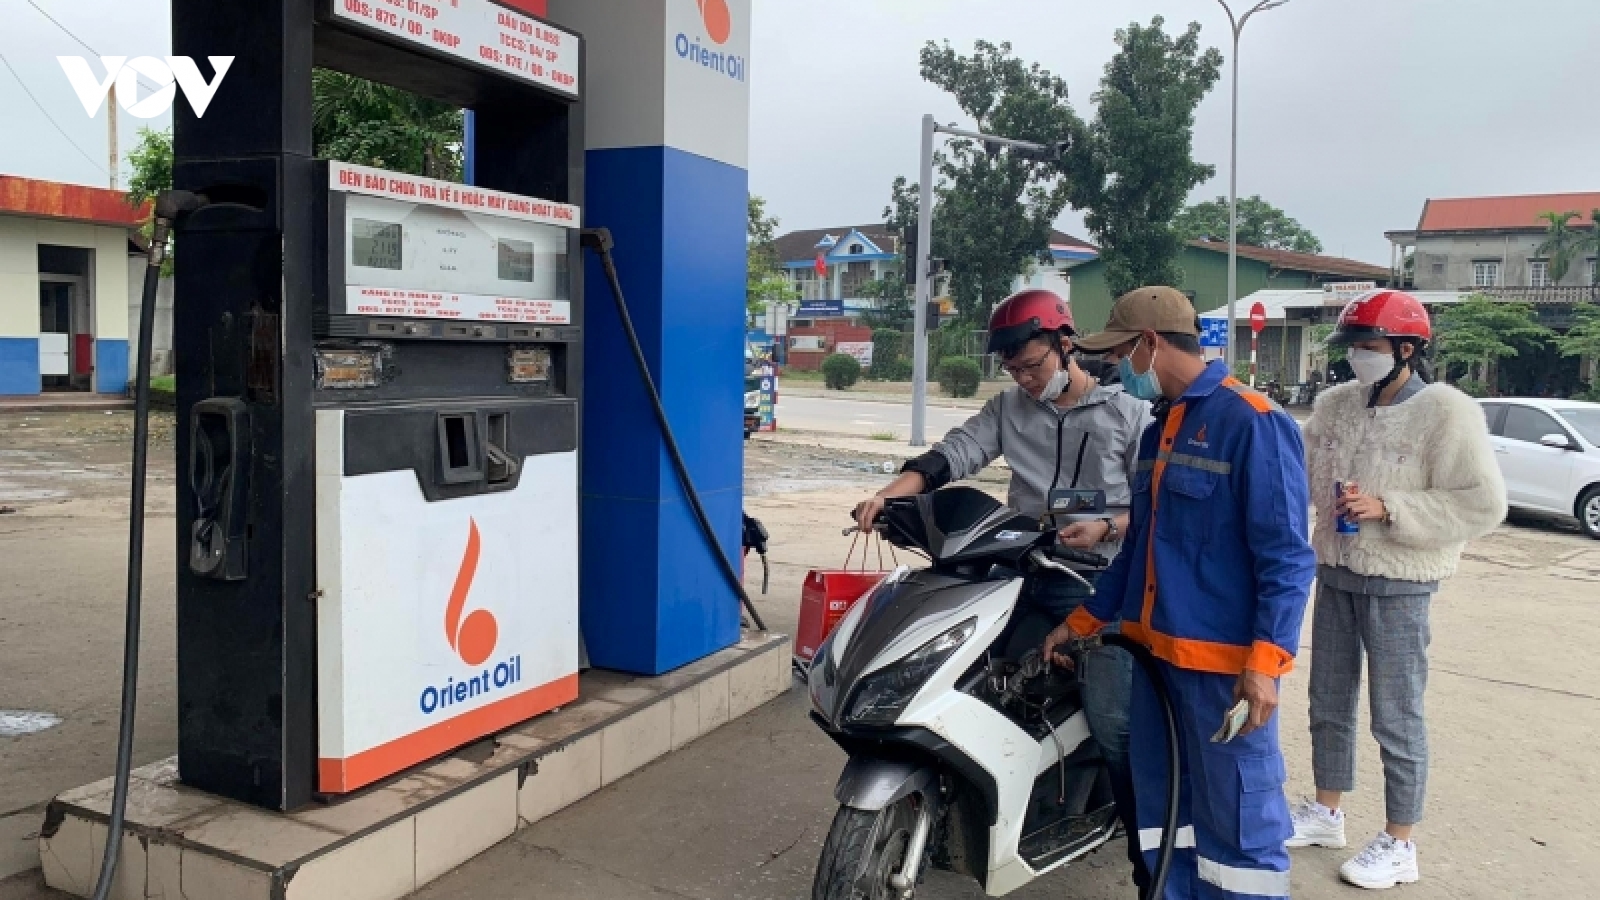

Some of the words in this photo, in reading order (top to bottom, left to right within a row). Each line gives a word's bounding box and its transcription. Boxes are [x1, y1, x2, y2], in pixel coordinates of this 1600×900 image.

[675, 32, 725, 74] Orient
[728, 54, 745, 82] Oil
[420, 669, 490, 714] Orient
[493, 654, 521, 688] Oil
